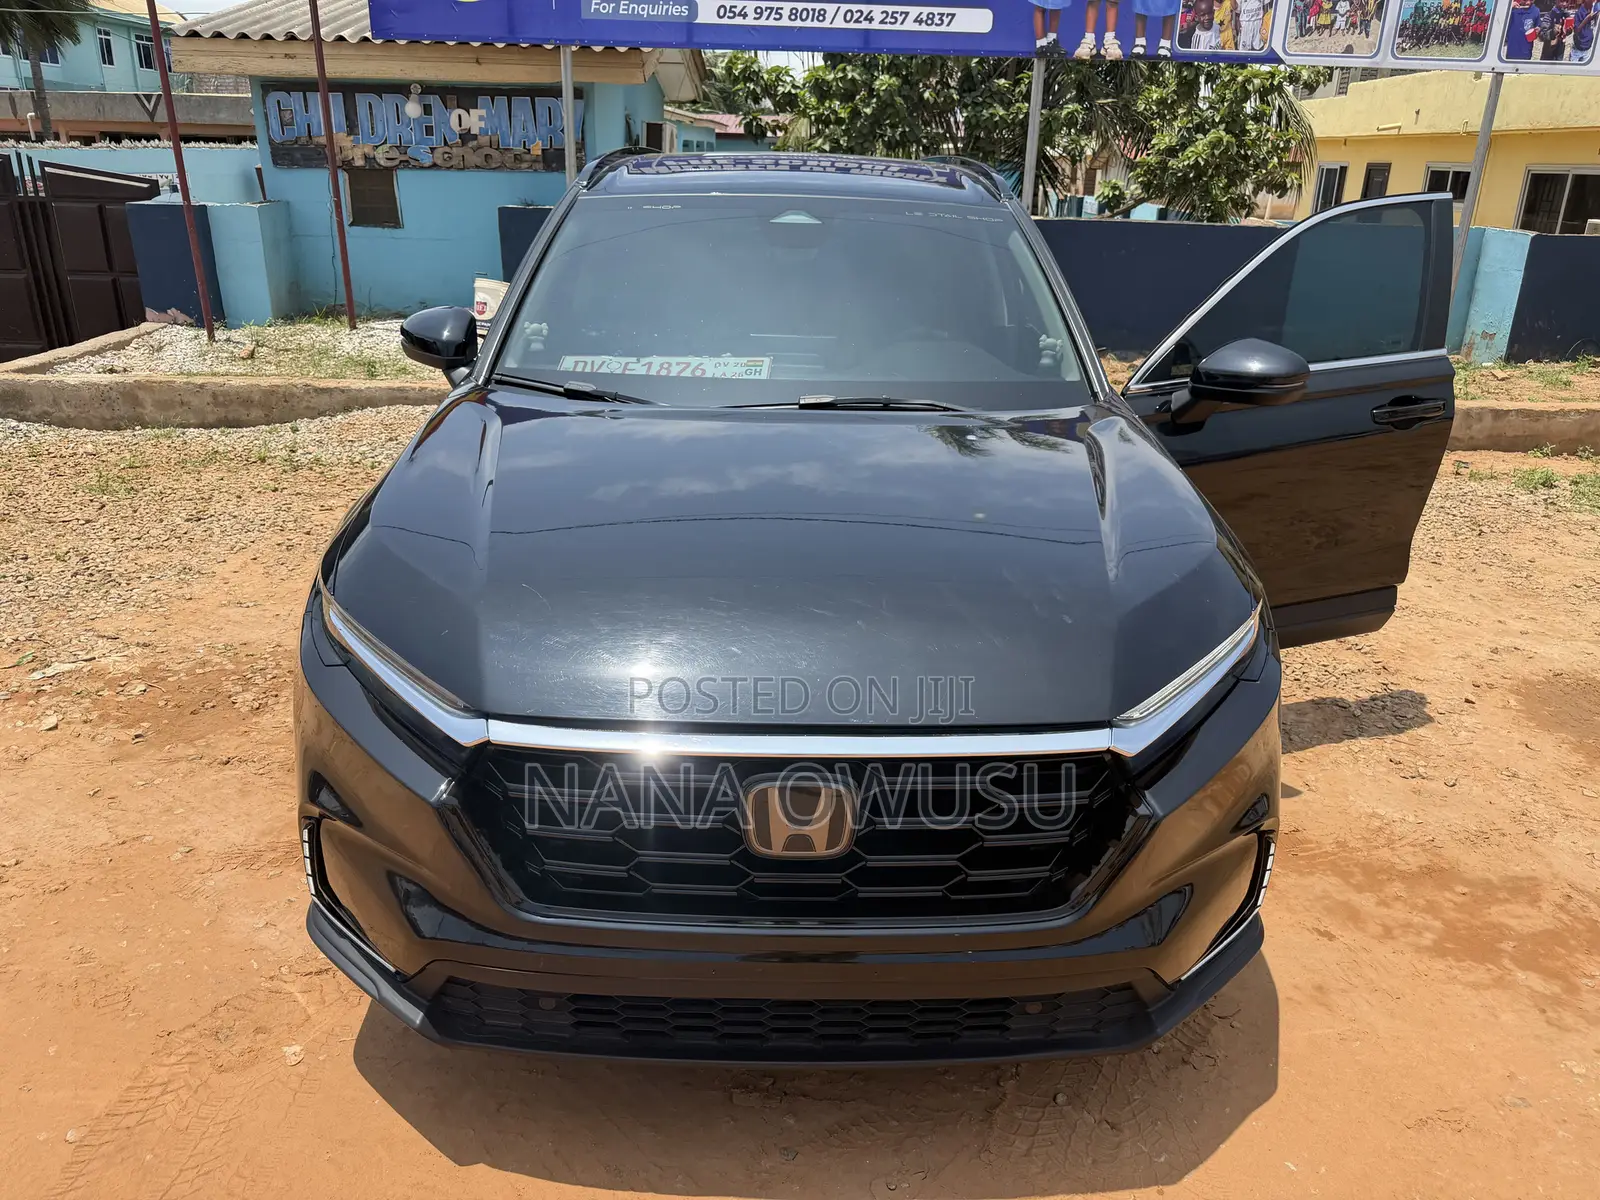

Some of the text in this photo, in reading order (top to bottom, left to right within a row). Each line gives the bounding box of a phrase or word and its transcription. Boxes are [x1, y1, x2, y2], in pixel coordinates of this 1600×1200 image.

[590, 1, 614, 14] For
[618, 1, 689, 17] Enquiries
[716, 4, 748, 20] 054
[752, 7, 784, 22] 975
[788, 8, 827, 23] 8018
[843, 9, 875, 24] 024
[878, 10, 910, 26] 257
[912, 12, 956, 27] 4837
[266, 91, 460, 146] CHLDREN
[450, 108, 487, 134] OF
[744, 368, 763, 376] GH
